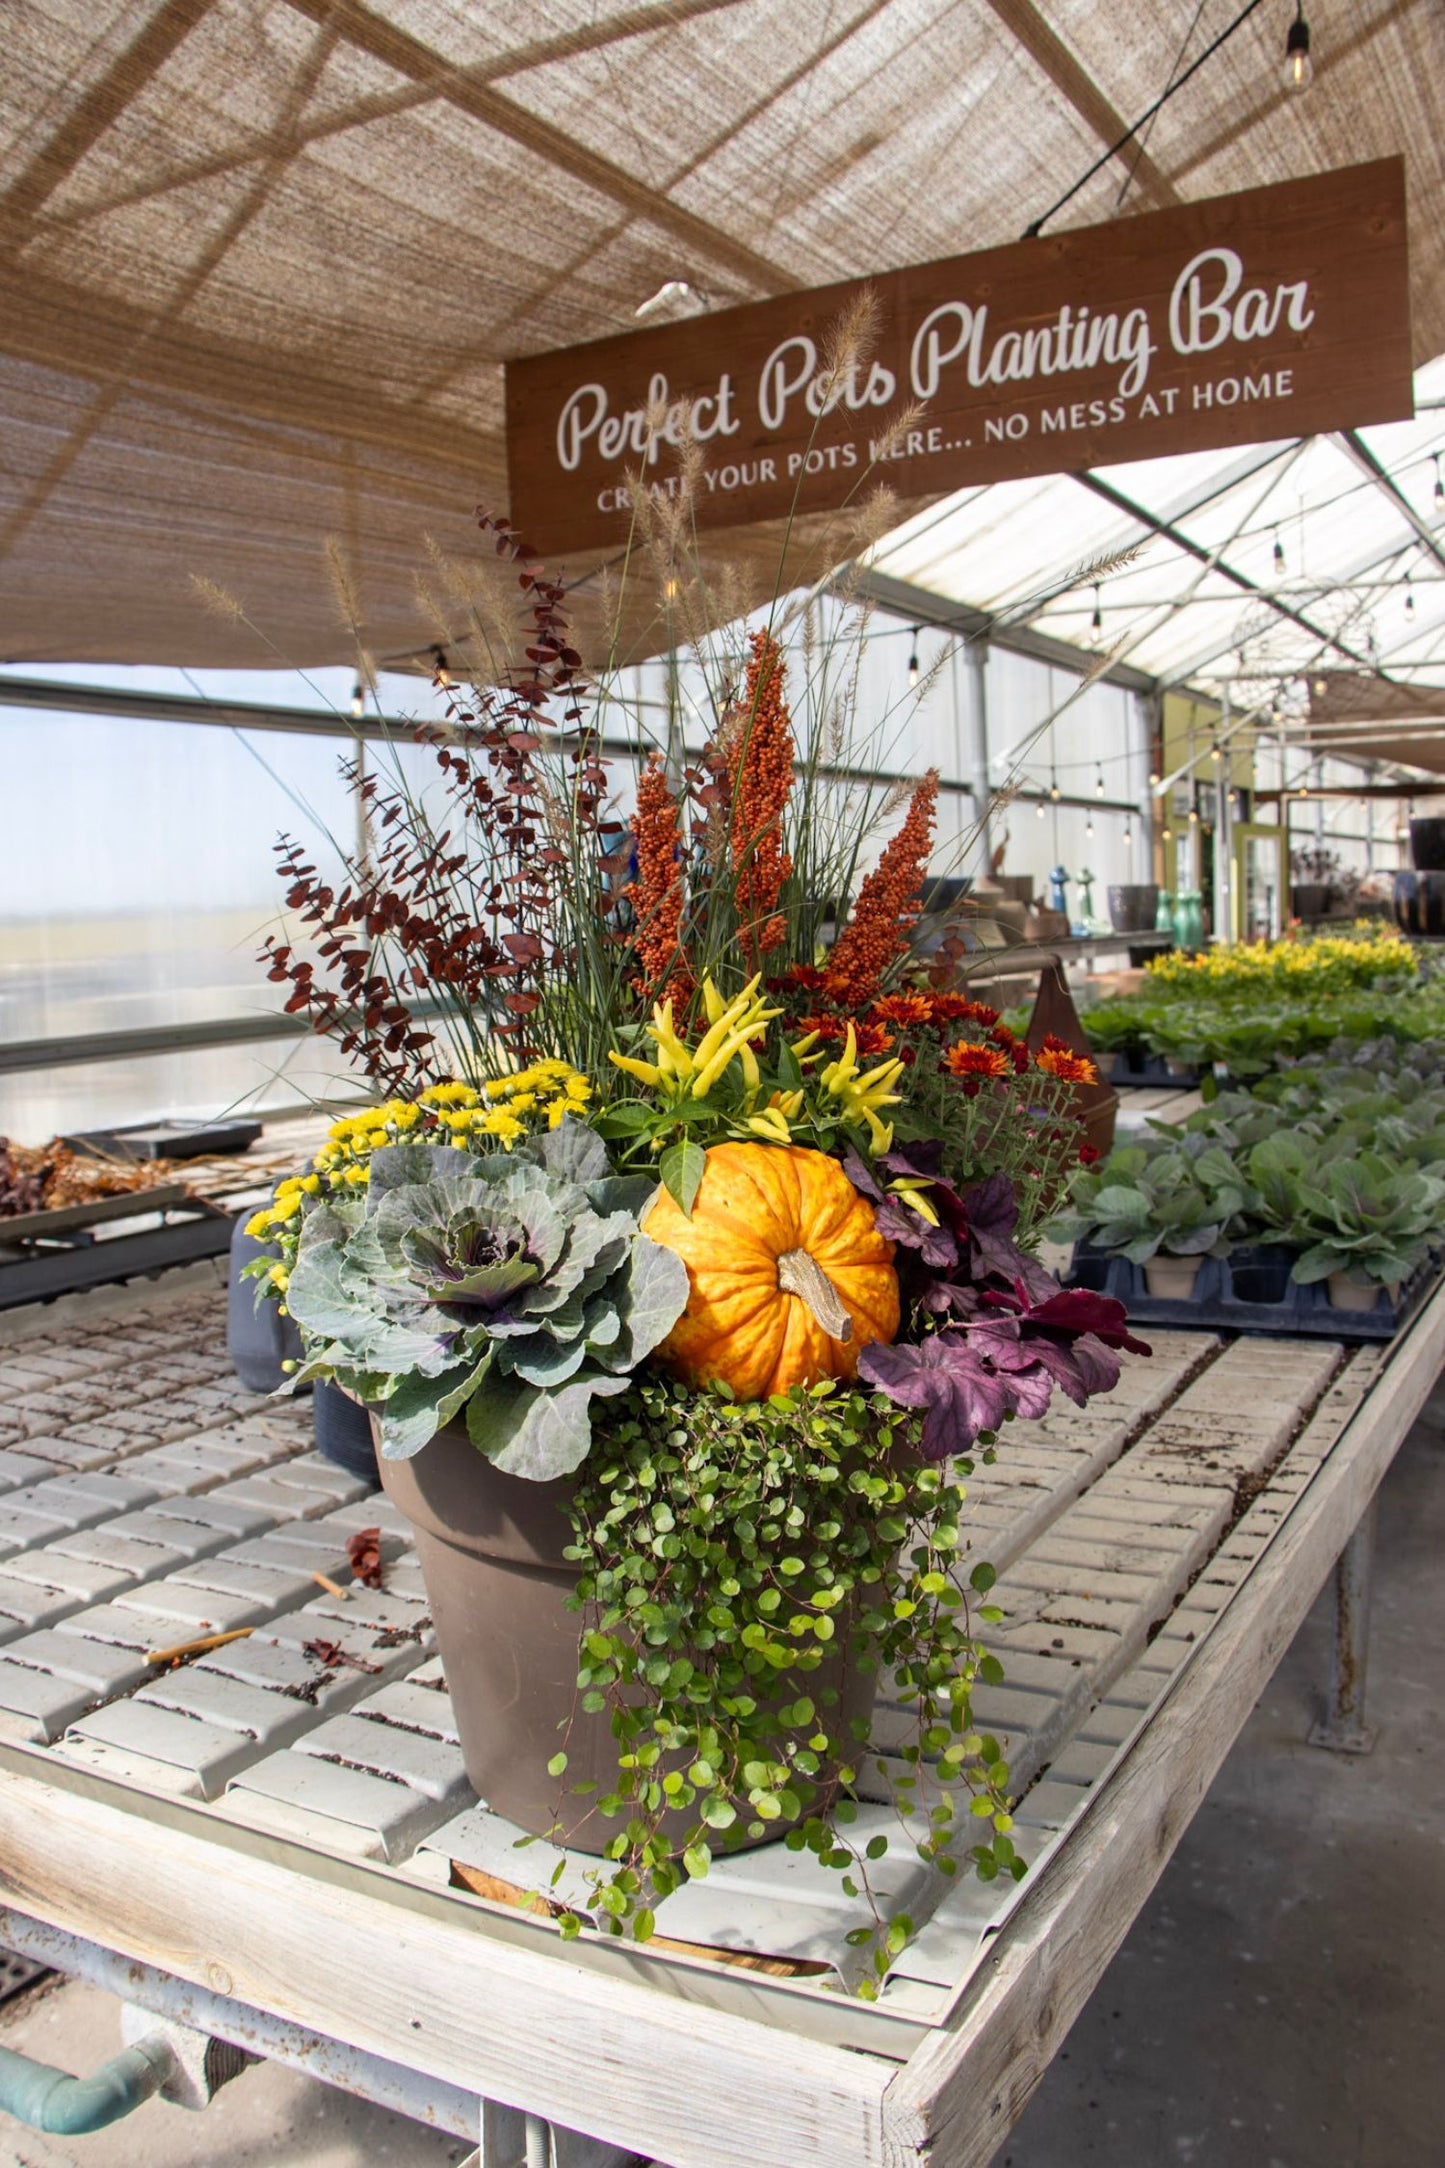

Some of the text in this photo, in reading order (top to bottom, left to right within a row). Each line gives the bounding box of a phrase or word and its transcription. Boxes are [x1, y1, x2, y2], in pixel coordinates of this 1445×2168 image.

[557, 247, 1315, 471] Perfect Pots Planting Bar
[597, 475, 694, 512] CRAT
[704, 458, 777, 492] YOUR
[787, 443, 858, 477] POTS
[984, 412, 1029, 442] NO
[1040, 397, 1126, 434] MESS
[1138, 387, 1180, 419] AT
[1192, 369, 1294, 410] HOME
